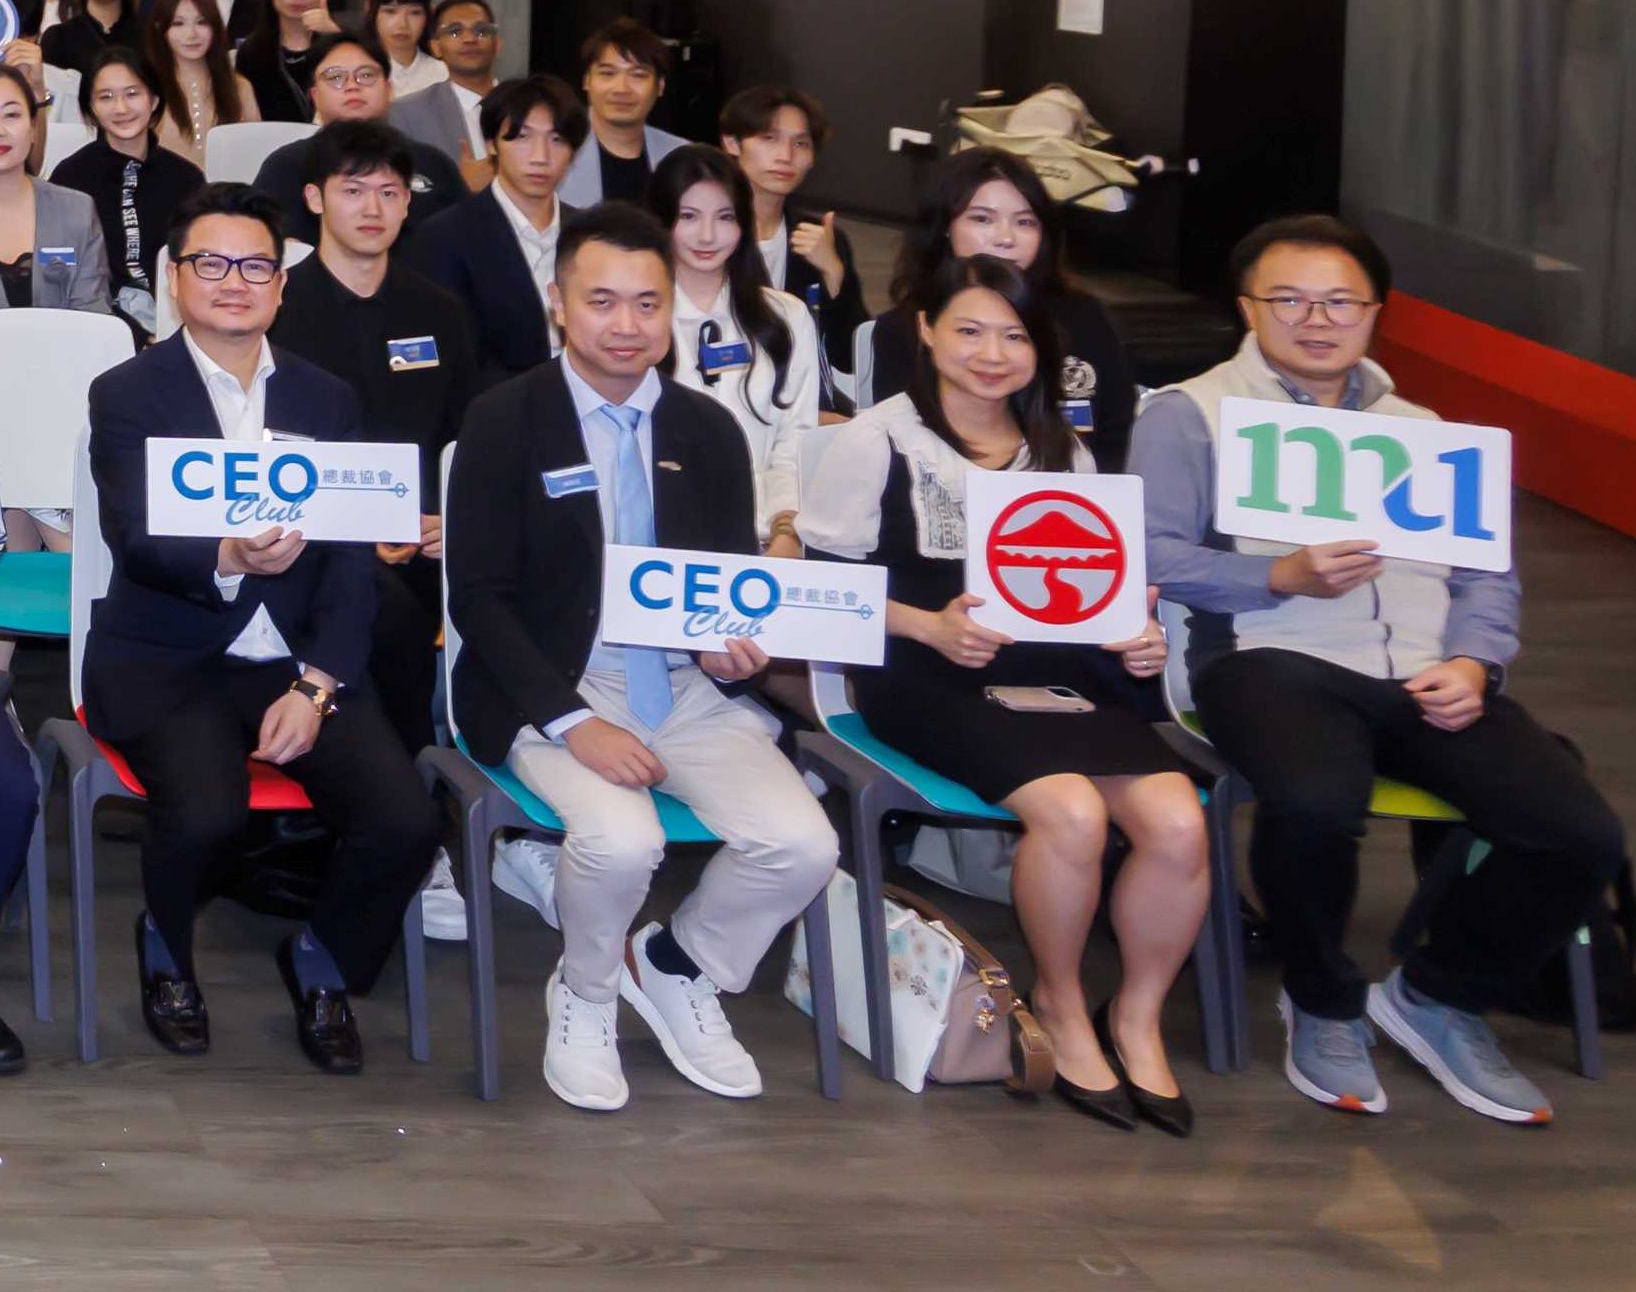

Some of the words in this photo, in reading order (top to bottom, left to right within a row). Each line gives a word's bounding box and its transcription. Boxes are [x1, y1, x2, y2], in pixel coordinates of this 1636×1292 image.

[122, 208, 139, 226] SEE
[171, 451, 319, 503] CEO
[225, 492, 305, 525] Club
[629, 560, 782, 618] CEO
[683, 607, 766, 638] Club
